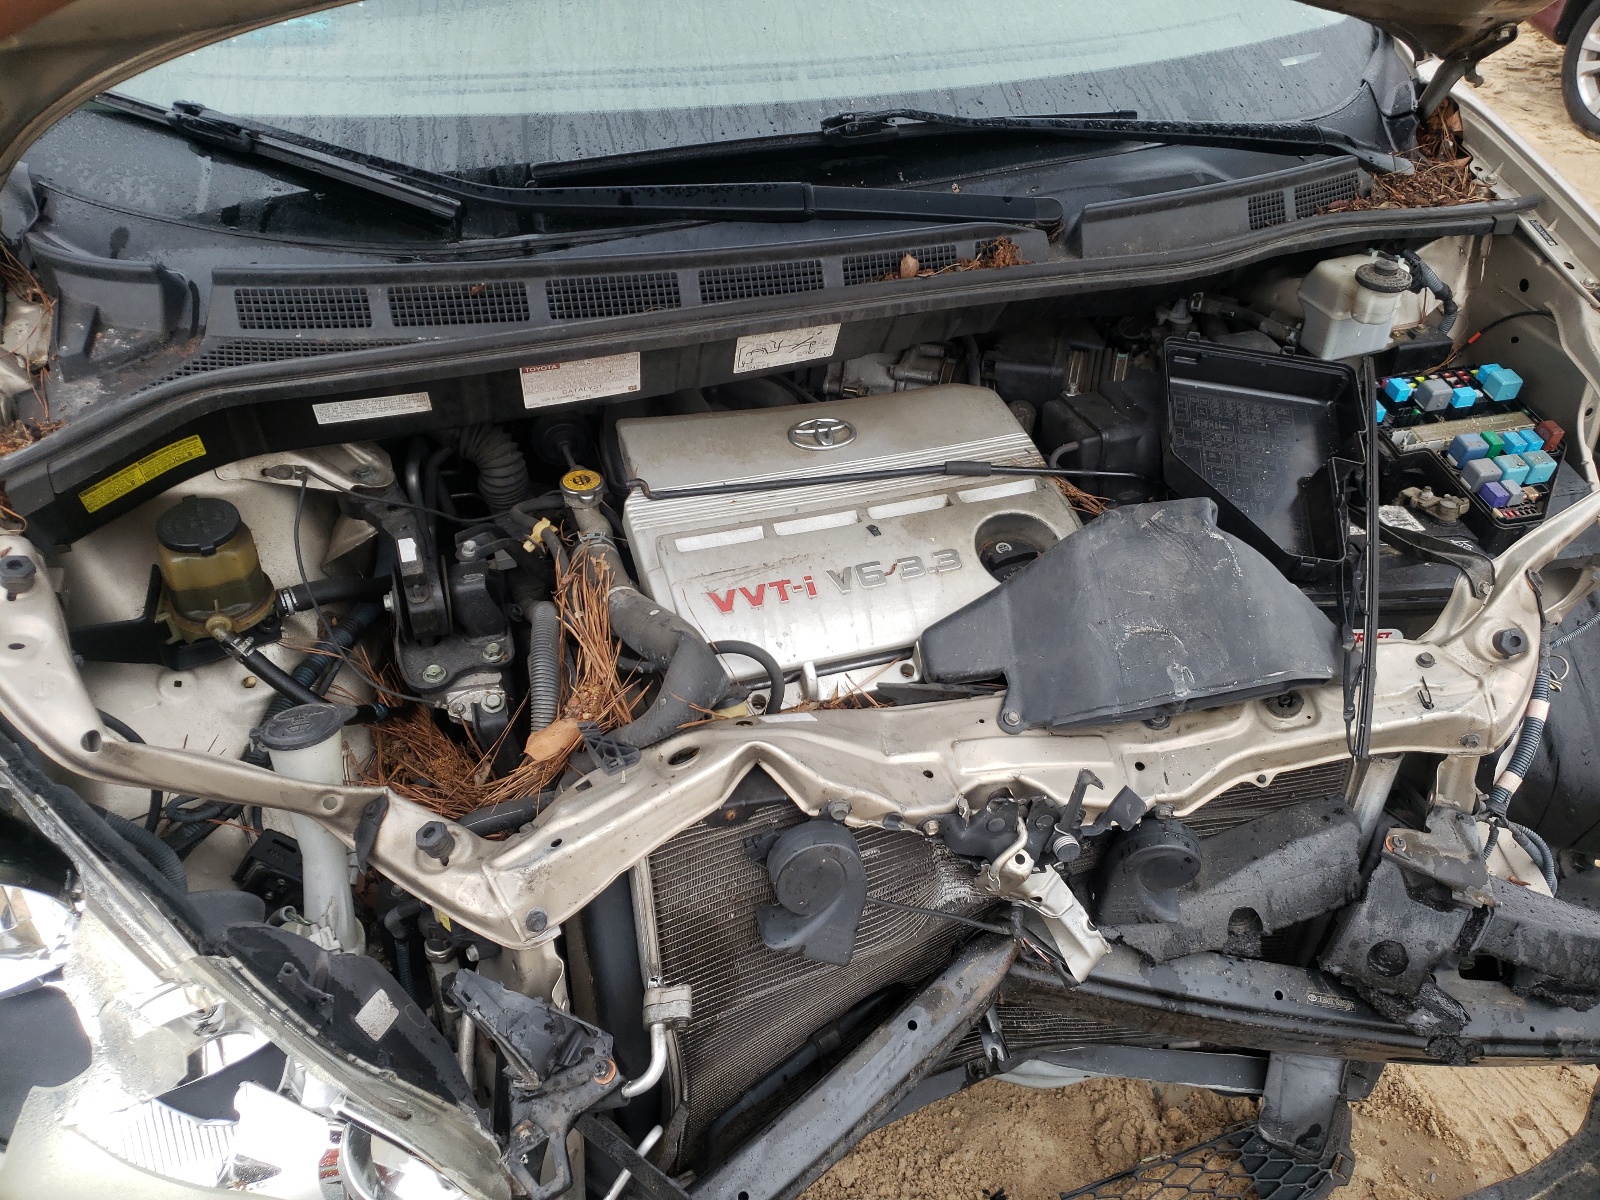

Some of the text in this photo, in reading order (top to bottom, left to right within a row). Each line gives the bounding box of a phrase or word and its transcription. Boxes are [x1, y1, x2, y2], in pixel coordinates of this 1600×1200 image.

[525, 364, 557, 373] TOYOTA
[562, 385, 602, 395] CATALYST
[706, 575, 817, 614] VVT-i
[825, 560, 888, 595] V6
[896, 549, 963, 580] 3.3
